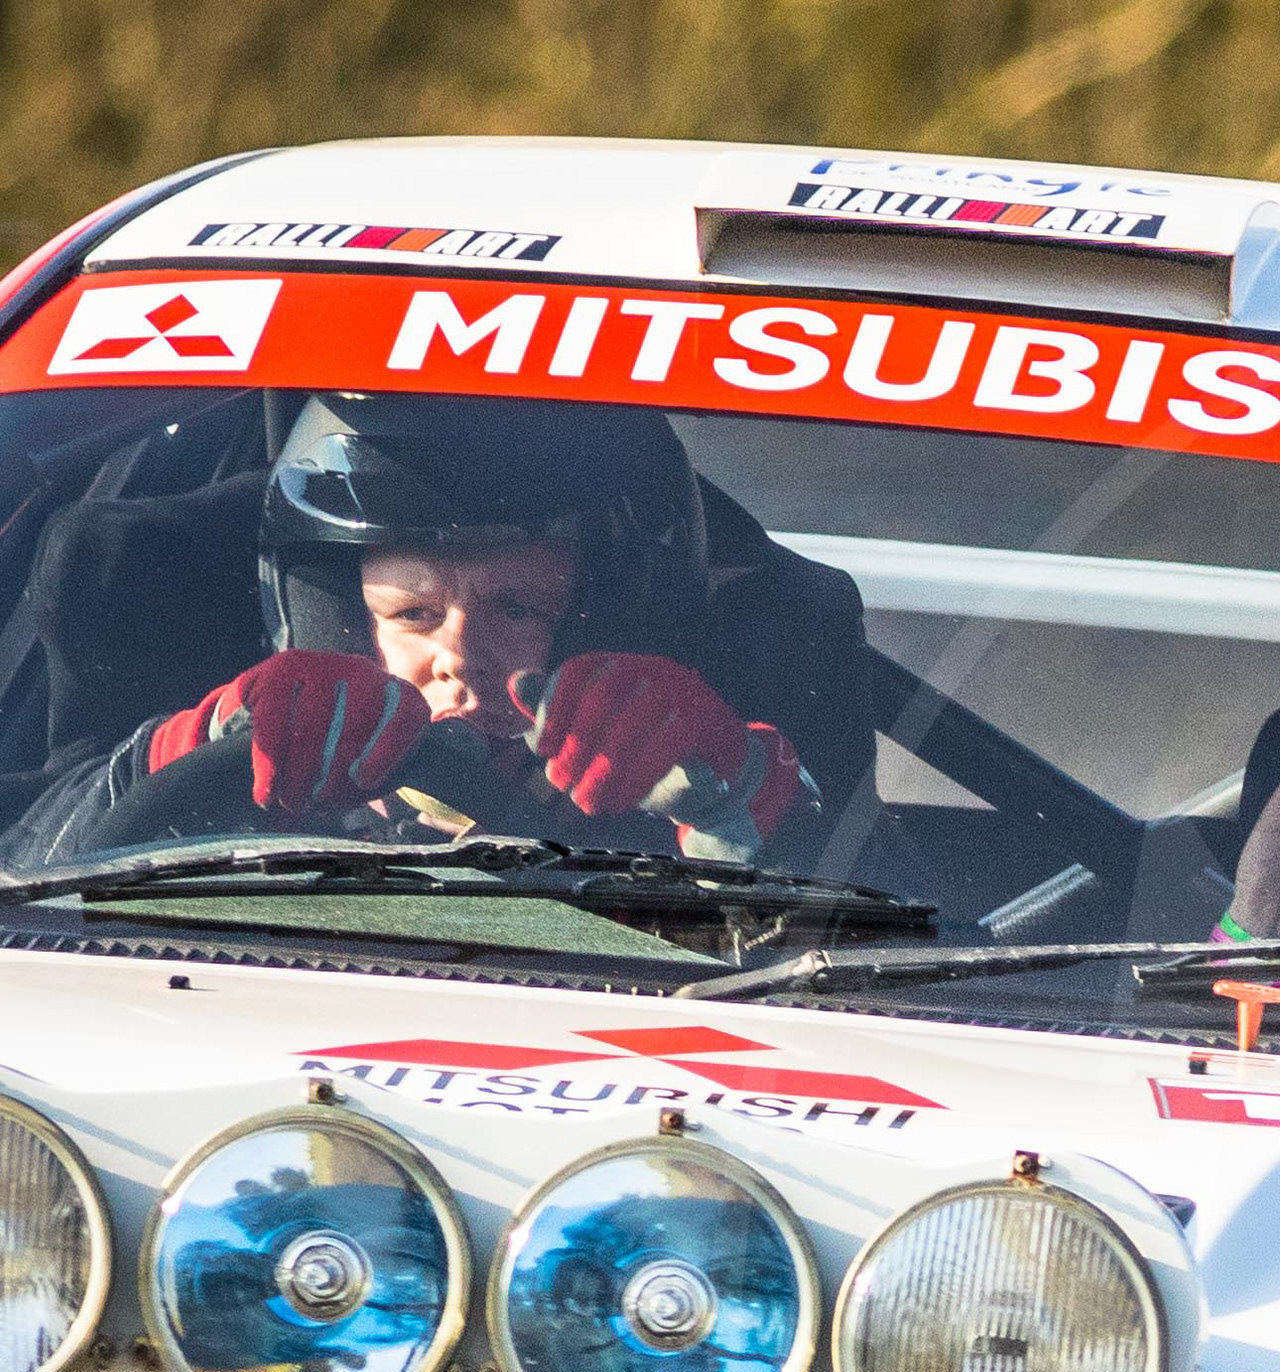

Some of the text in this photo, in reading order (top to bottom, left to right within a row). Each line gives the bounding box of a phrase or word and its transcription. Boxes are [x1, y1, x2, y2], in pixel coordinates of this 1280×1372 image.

[804, 184, 1154, 238] RALLI ART
[202, 223, 547, 260] RALLI ART
